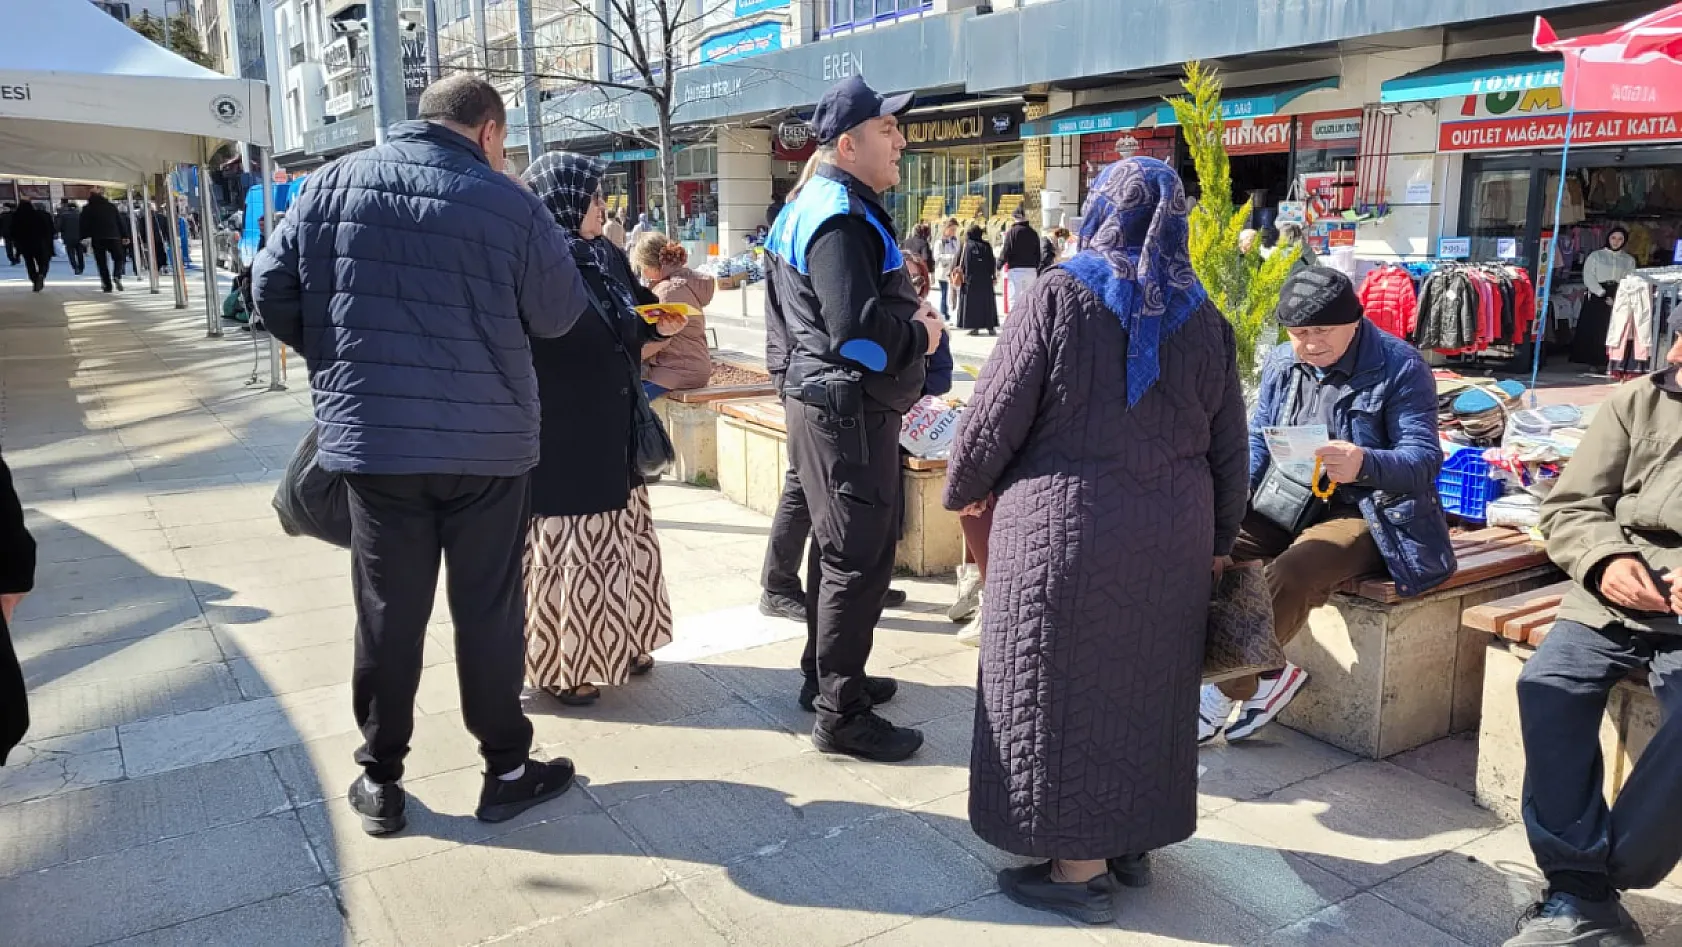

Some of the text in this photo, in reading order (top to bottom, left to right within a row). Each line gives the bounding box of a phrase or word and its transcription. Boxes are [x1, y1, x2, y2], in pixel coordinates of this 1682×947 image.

[822, 49, 863, 81] EREN
[908, 116, 983, 142] KUYUMCU
[1452, 115, 1677, 146] OUTLET MAĞAZAMIZ ALT KATTA
